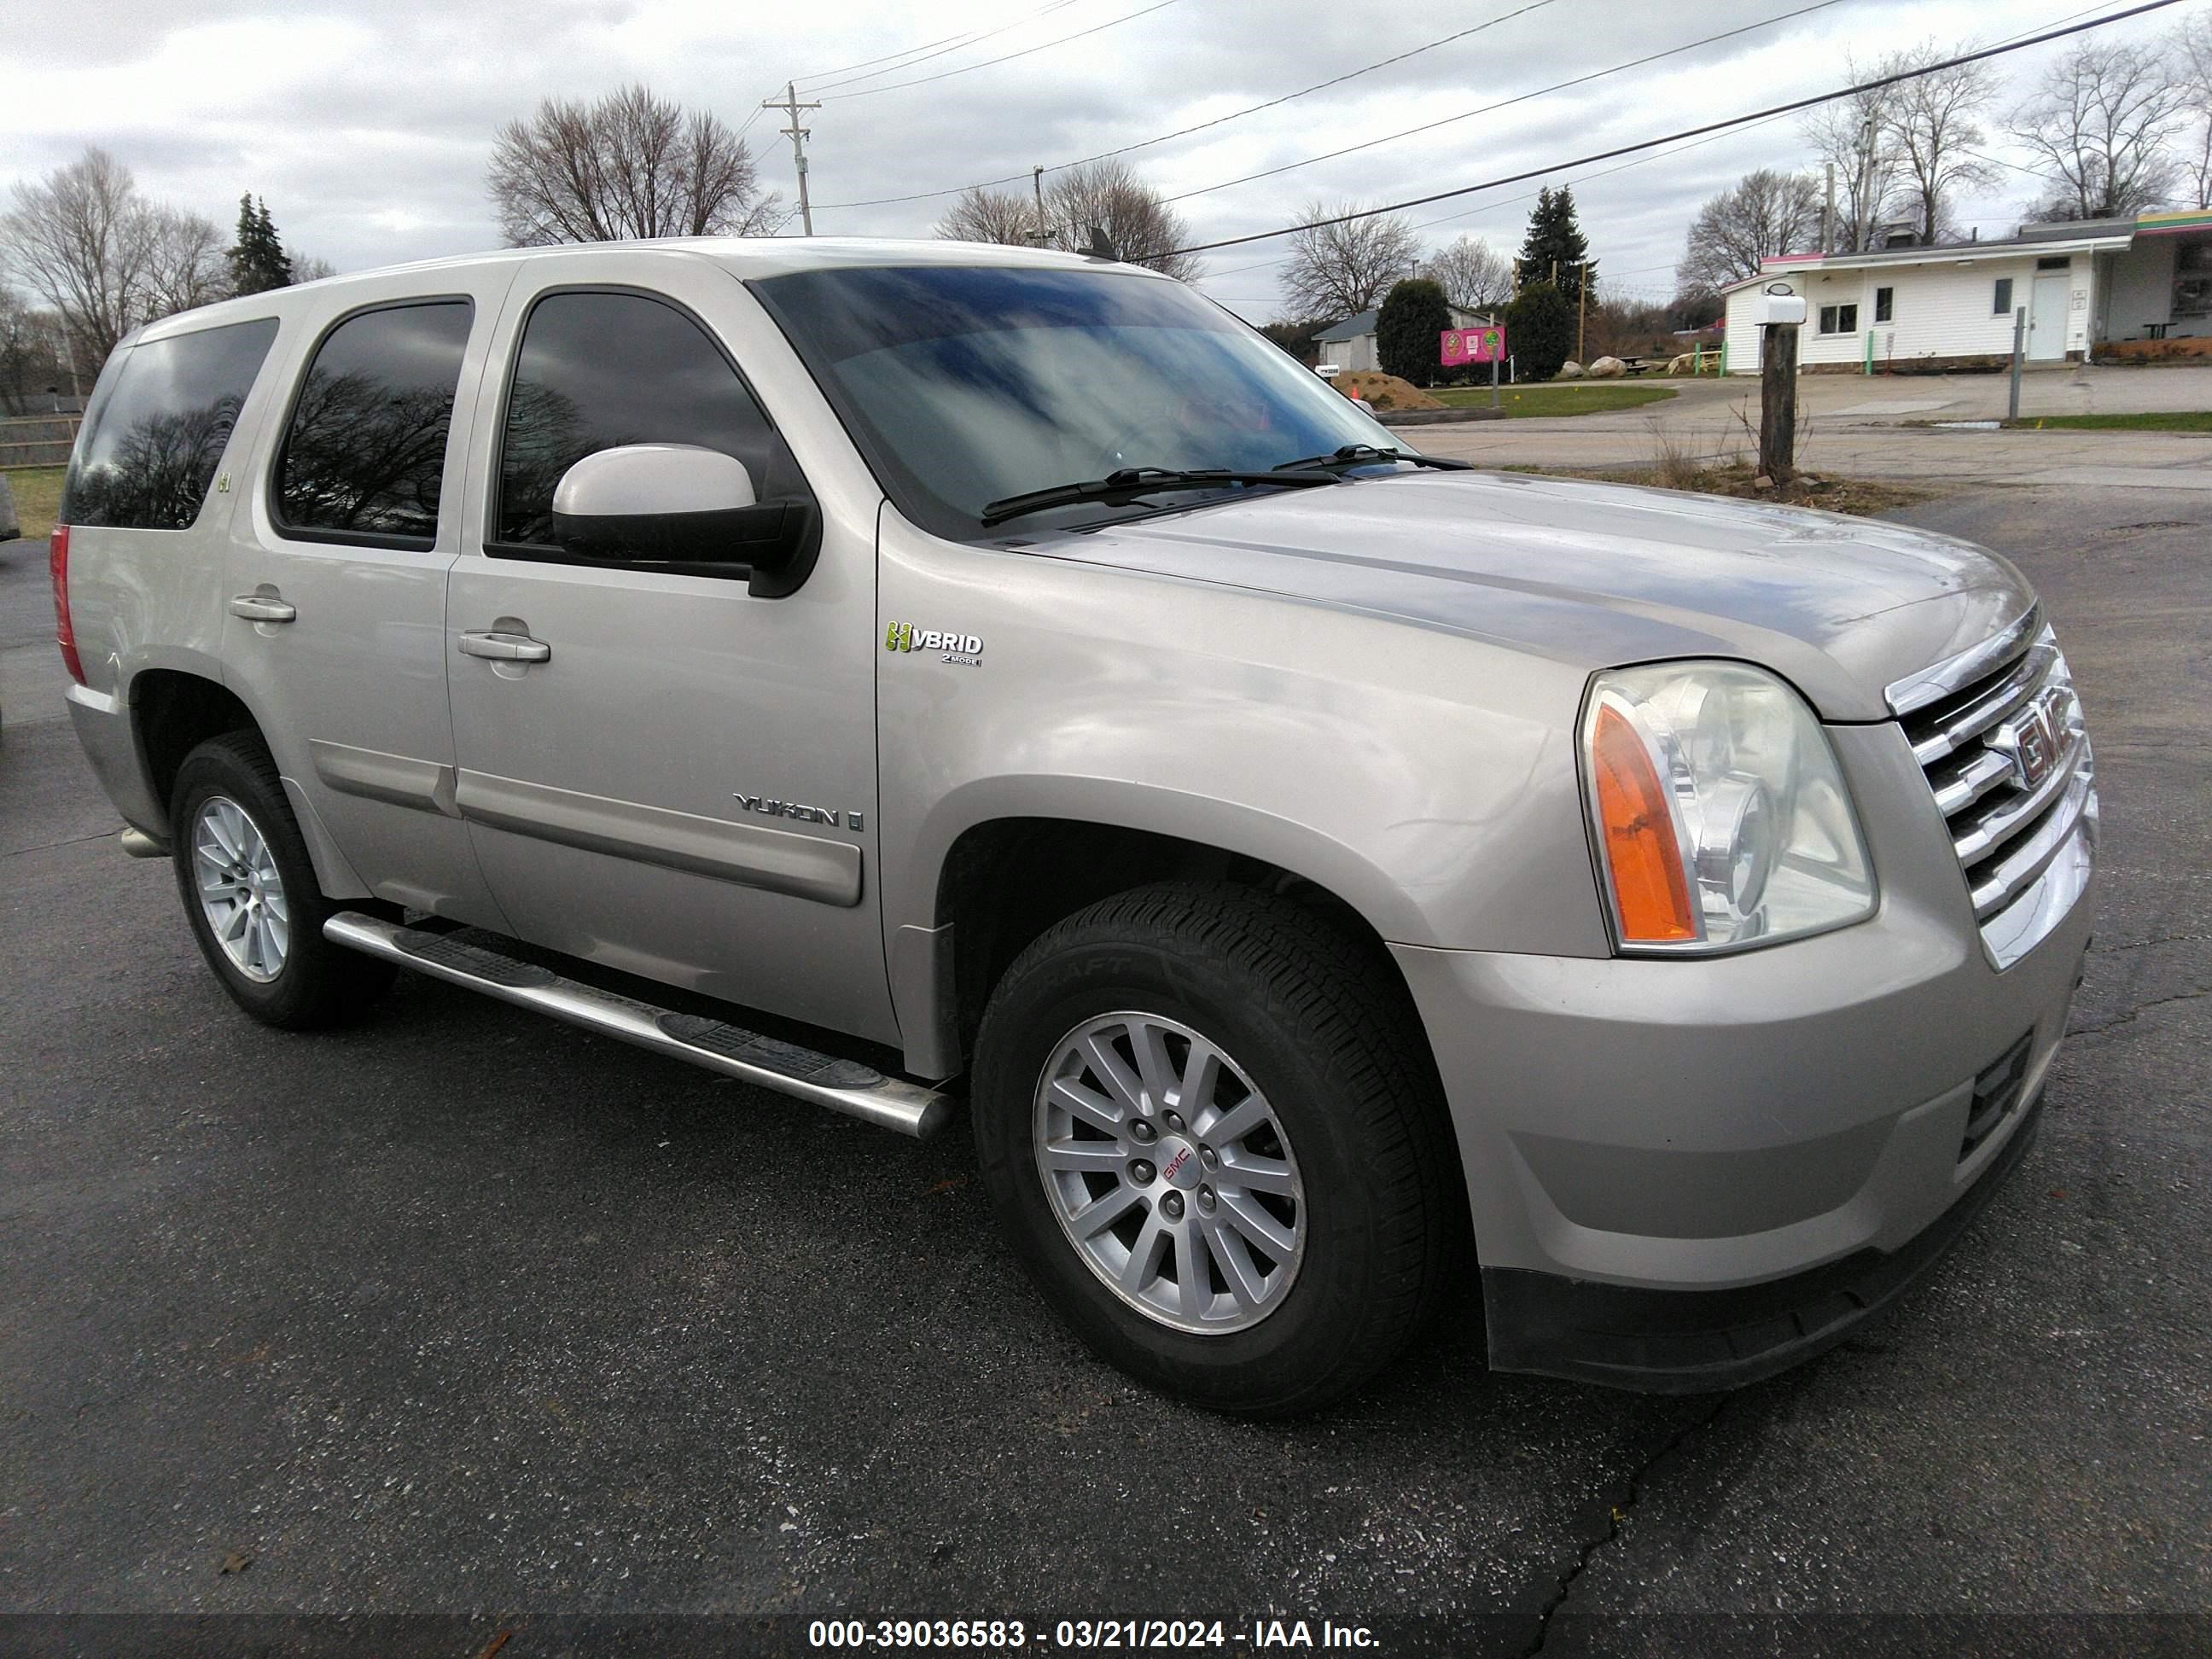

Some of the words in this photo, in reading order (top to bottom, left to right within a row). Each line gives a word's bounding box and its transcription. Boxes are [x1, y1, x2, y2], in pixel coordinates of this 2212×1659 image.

[886, 620, 983, 655] HYBRID
[732, 793, 840, 827] YUKON
[1163, 1147, 1191, 1180] GMC
